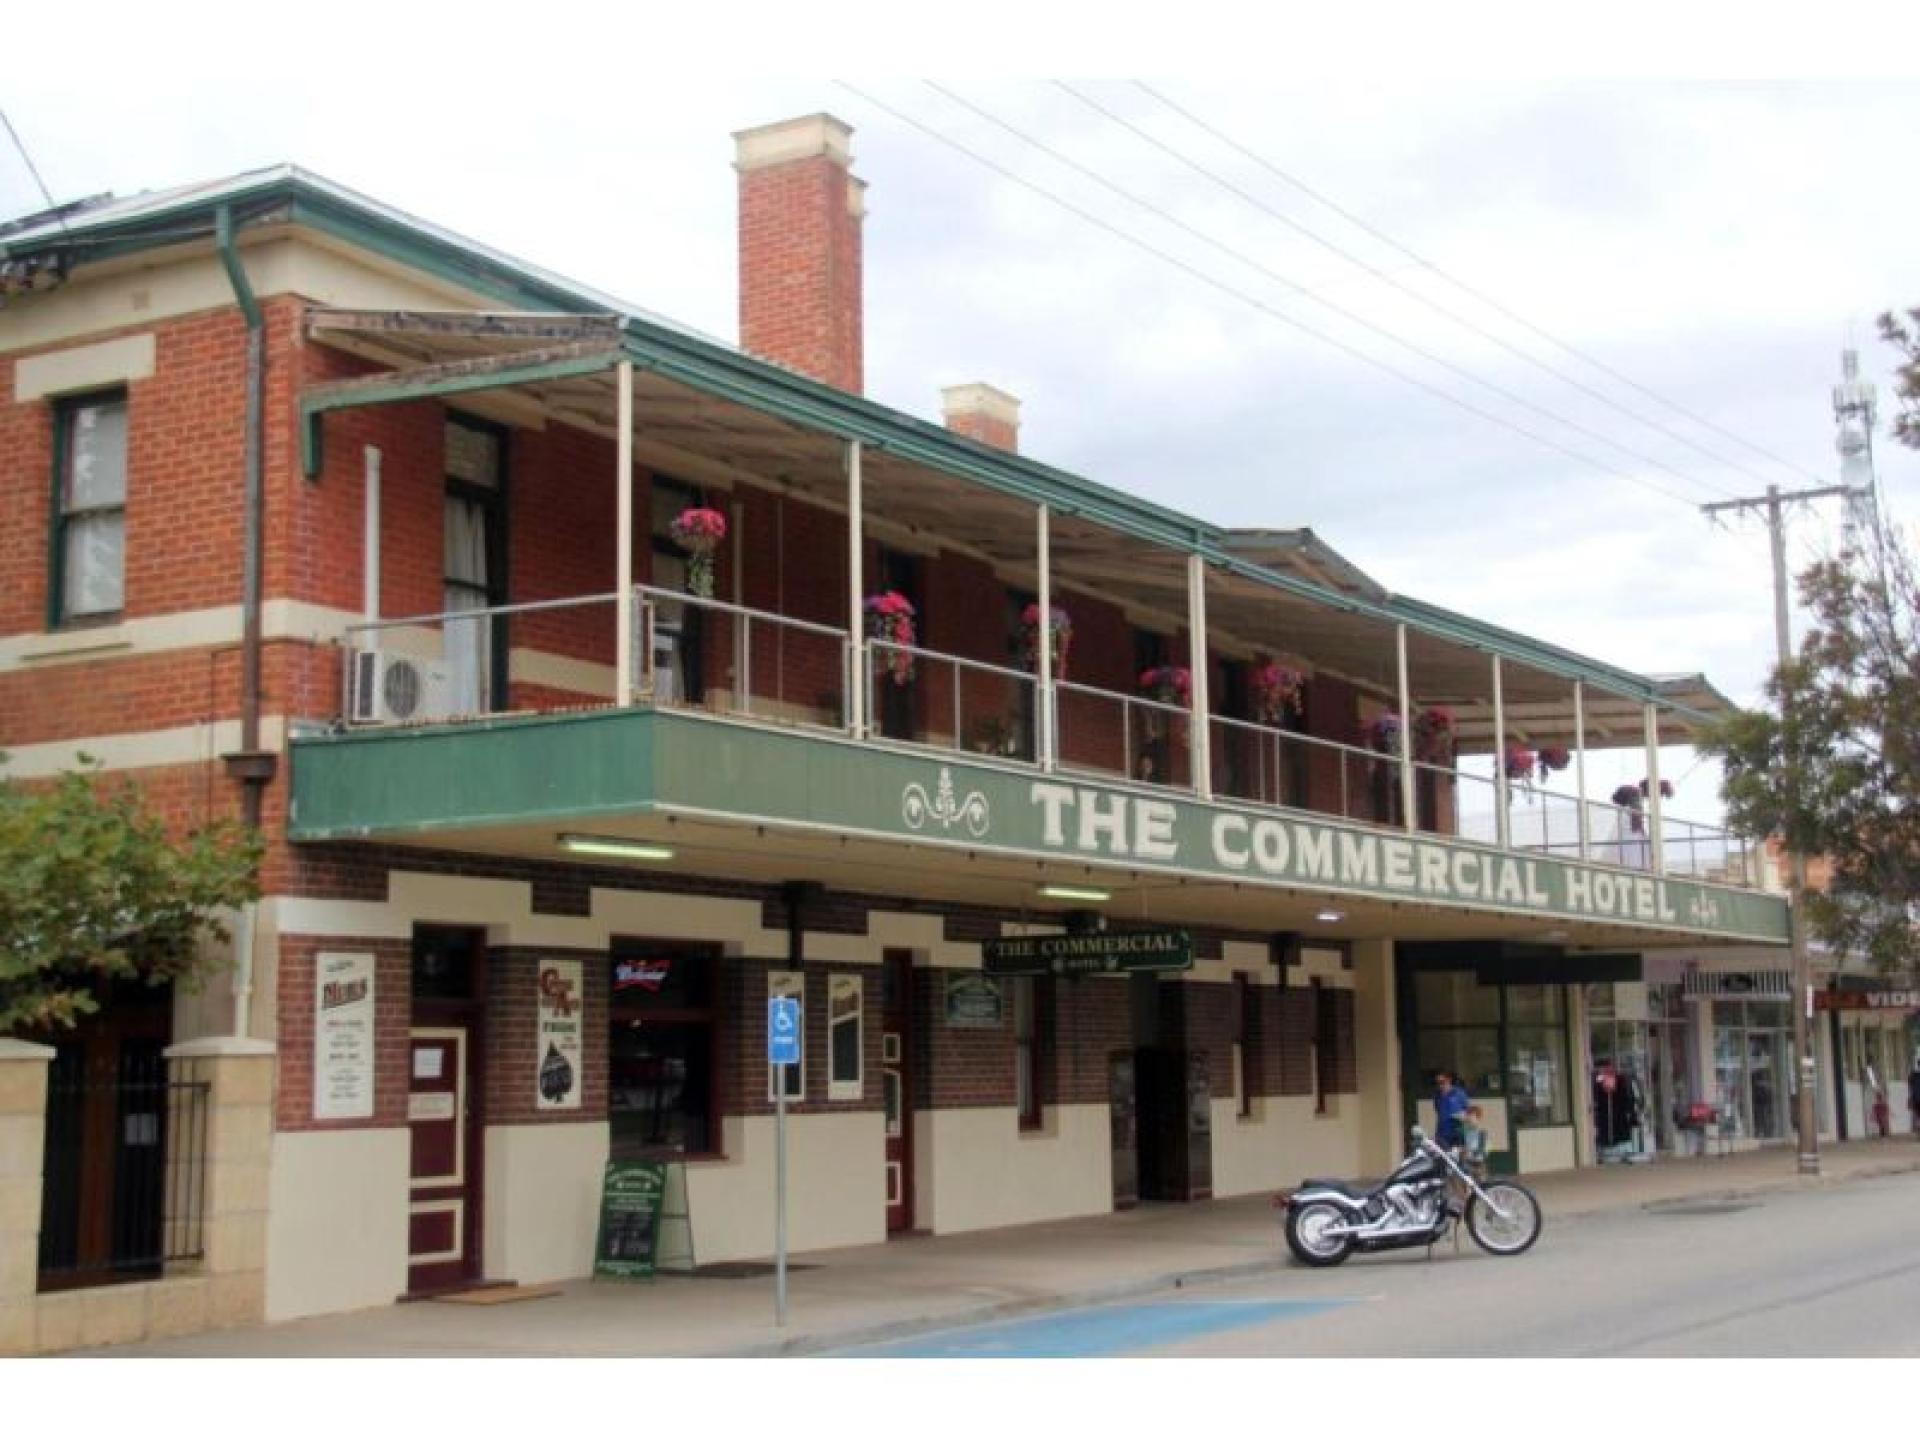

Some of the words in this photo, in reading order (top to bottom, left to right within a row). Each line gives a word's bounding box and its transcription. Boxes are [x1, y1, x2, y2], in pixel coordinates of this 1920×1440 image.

[1031, 783, 1177, 859] THE
[1211, 814, 1549, 907] COMMERCIAL
[1566, 868, 1676, 921] HOTEL
[998, 938, 1032, 957] THE
[1041, 934, 1179, 955] COMMERCIAL
